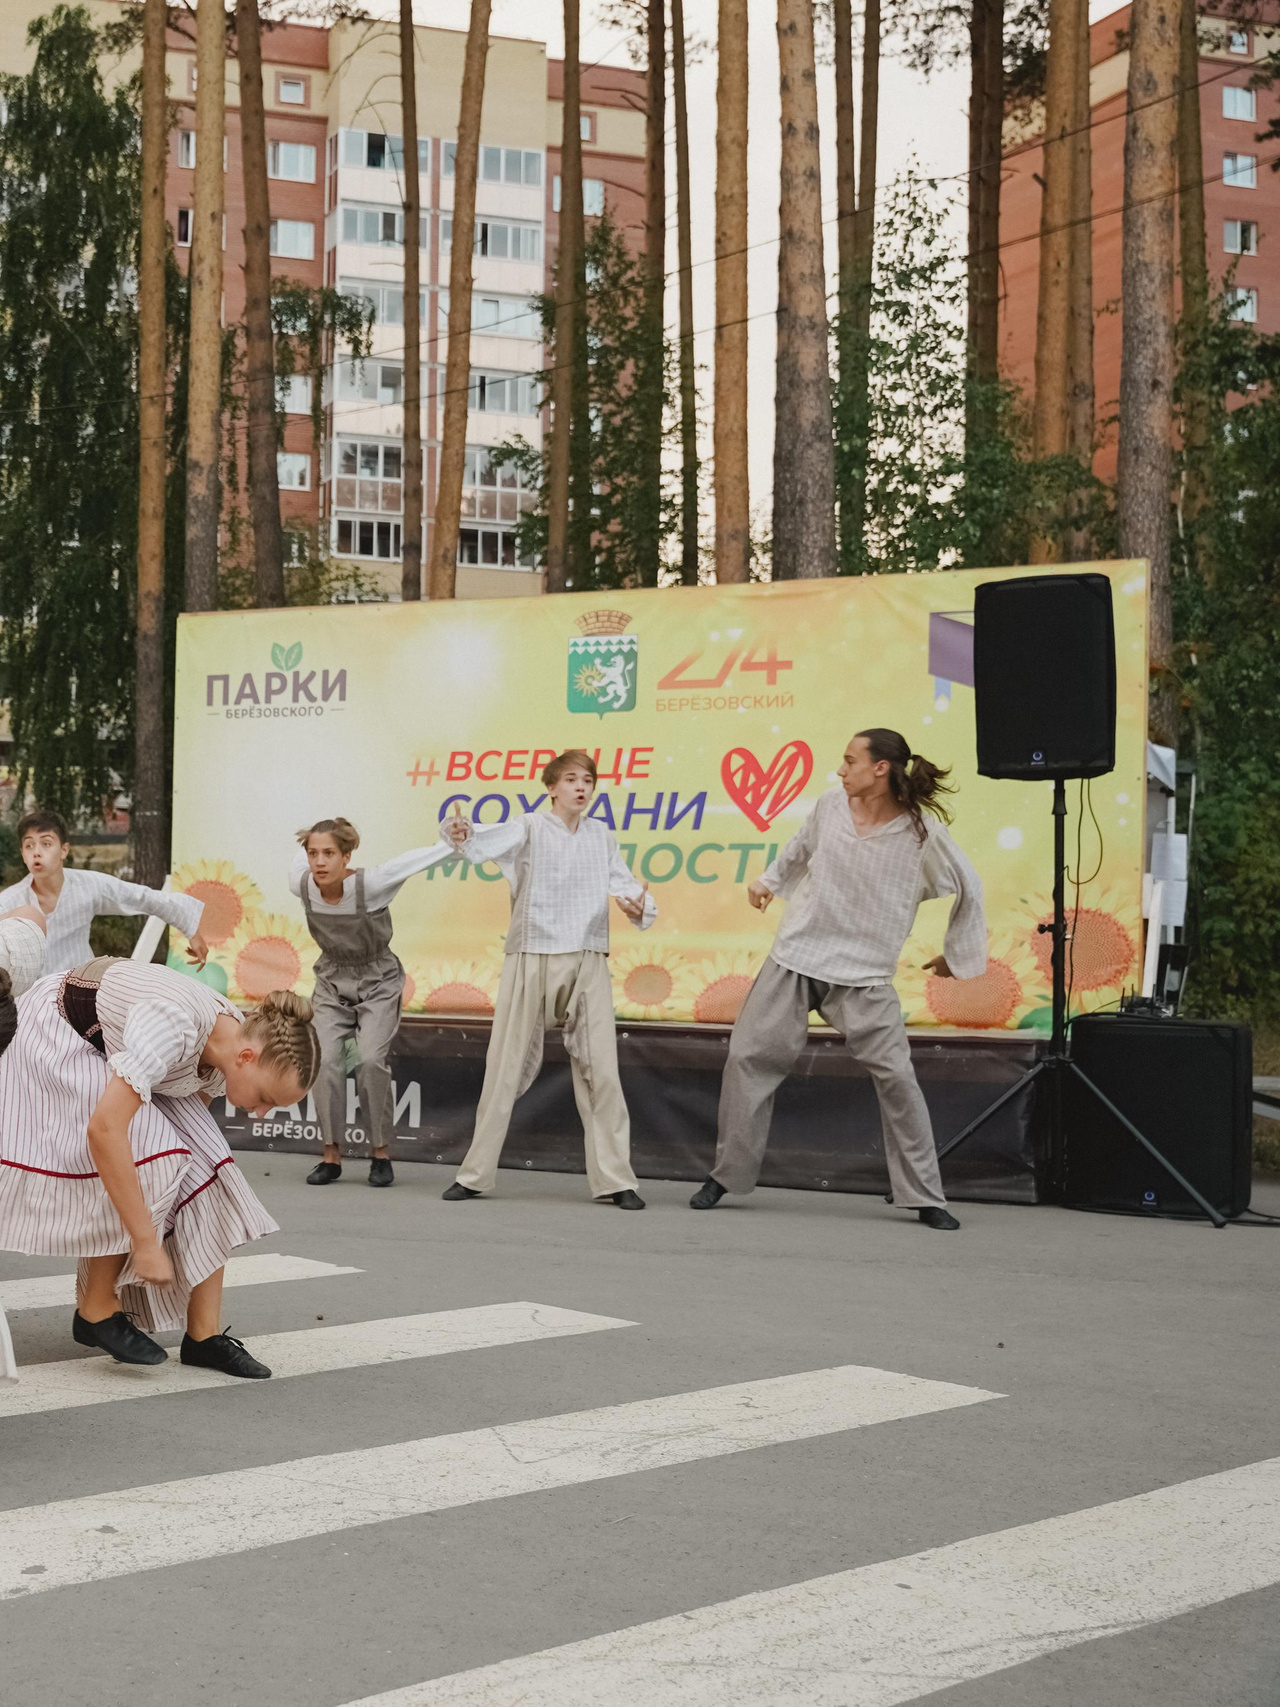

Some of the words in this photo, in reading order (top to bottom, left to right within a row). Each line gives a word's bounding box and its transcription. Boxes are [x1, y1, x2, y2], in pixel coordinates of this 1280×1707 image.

[206, 669, 347, 706] ПАРКИ
[655, 691, 793, 712] БЕРЁЗОВСКИЙ
[225, 705, 324, 719] БЕРЁЗОВСКОГО
[406, 747, 654, 787] #ВСЕРЦЕ
[438, 791, 707, 831] СОАНИ
